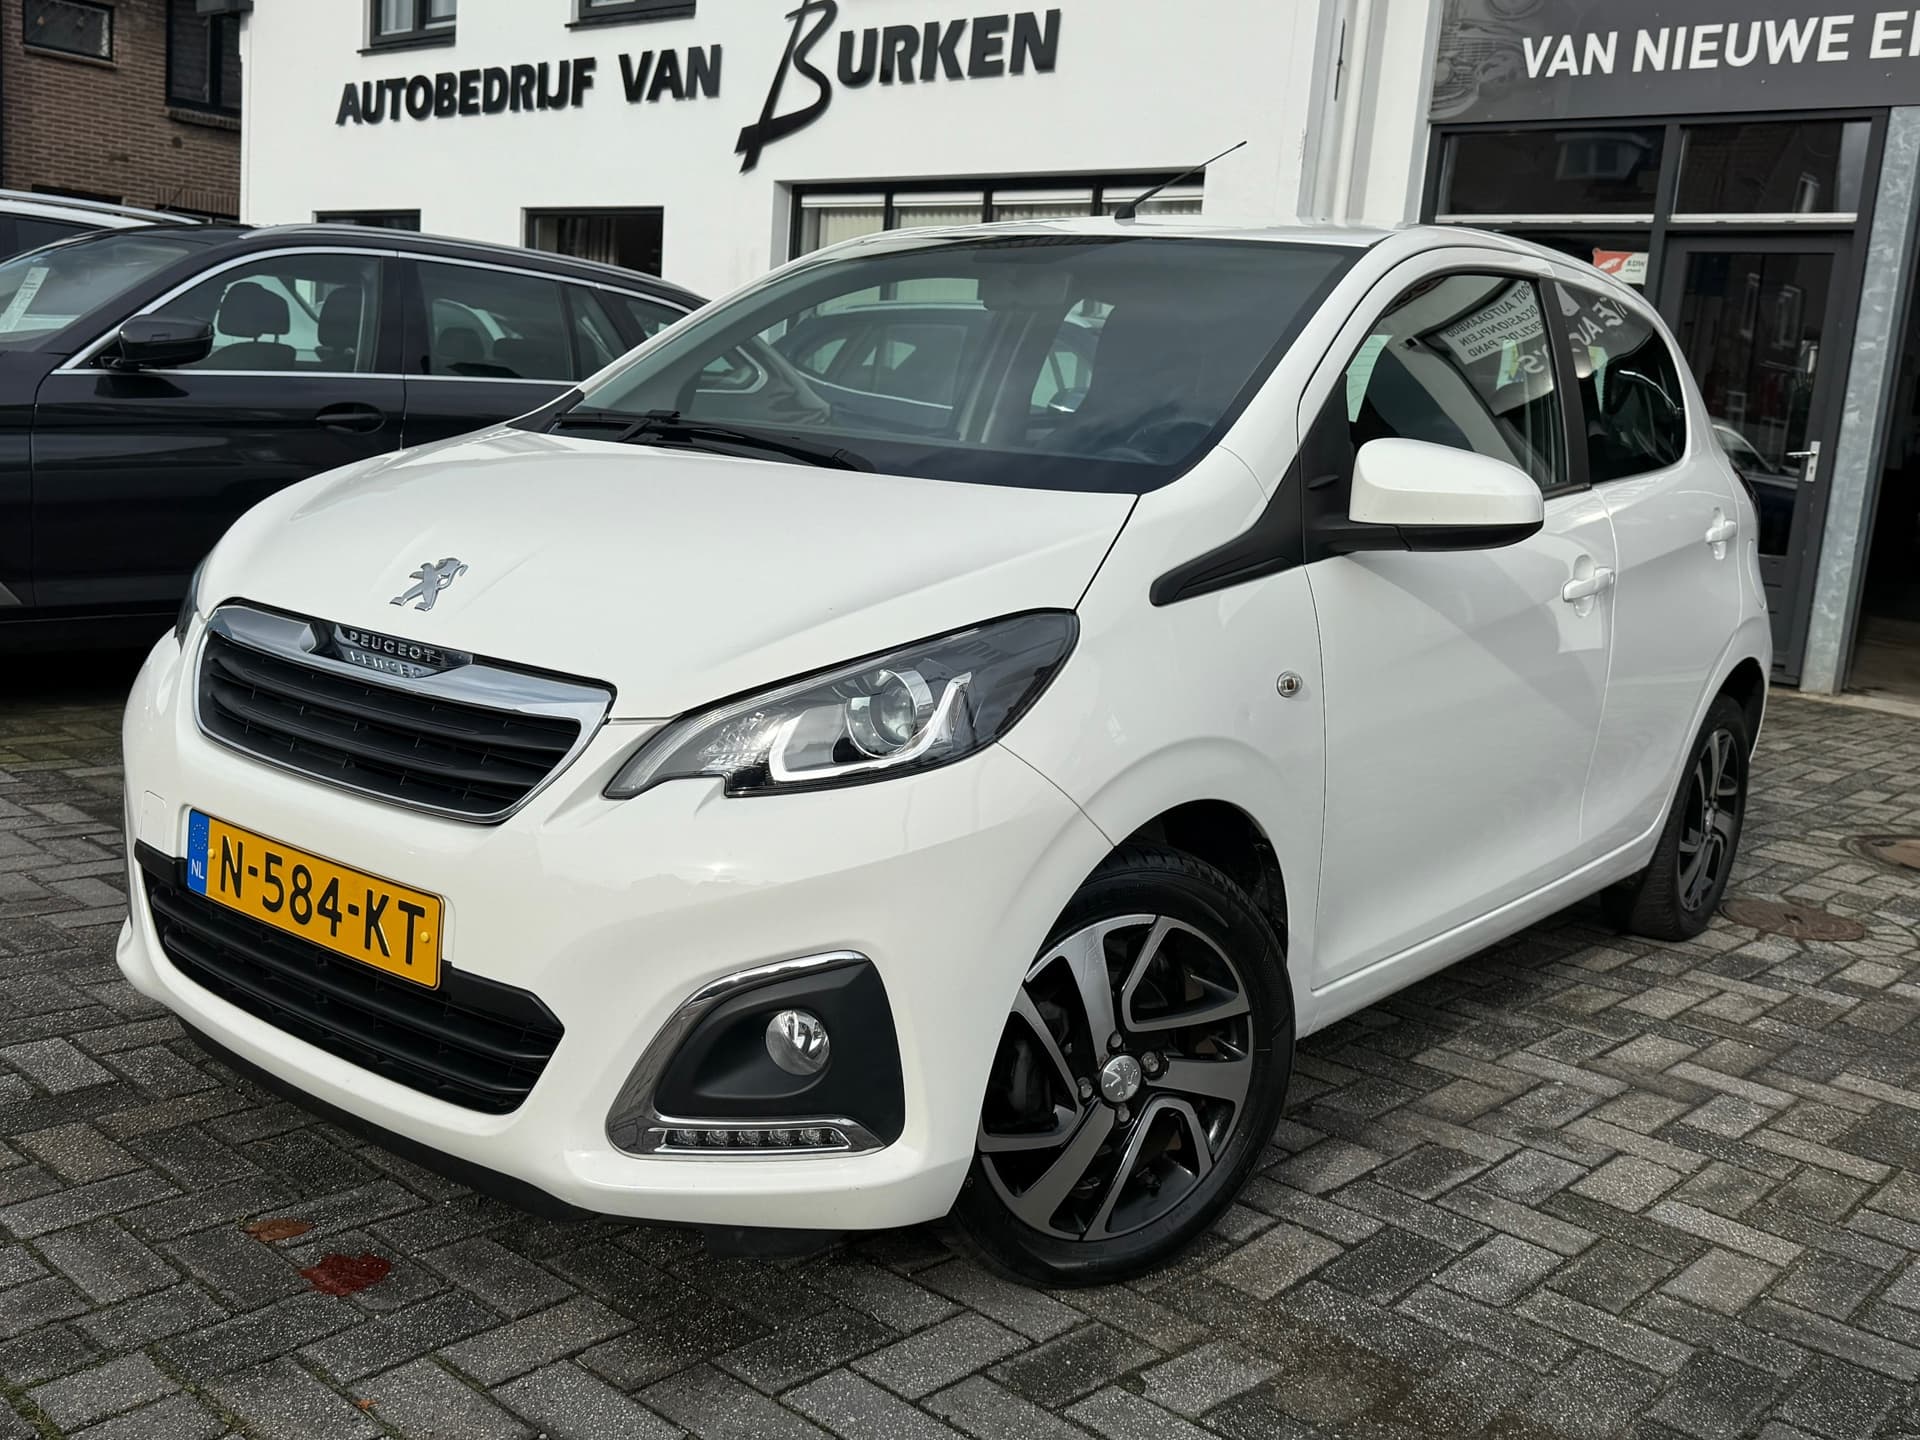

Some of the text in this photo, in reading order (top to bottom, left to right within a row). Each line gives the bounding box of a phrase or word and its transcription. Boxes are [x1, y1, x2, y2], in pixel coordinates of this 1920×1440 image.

[1522, 31, 1618, 79] VAN
[1632, 14, 1855, 73] NIEUWE
[335, 0, 1062, 176] AUTOBEDRIJF VAN BURKEN
[349, 629, 437, 662] PEUGEOT
[191, 858, 205, 880] NL
[219, 834, 426, 967] N-584-KT
